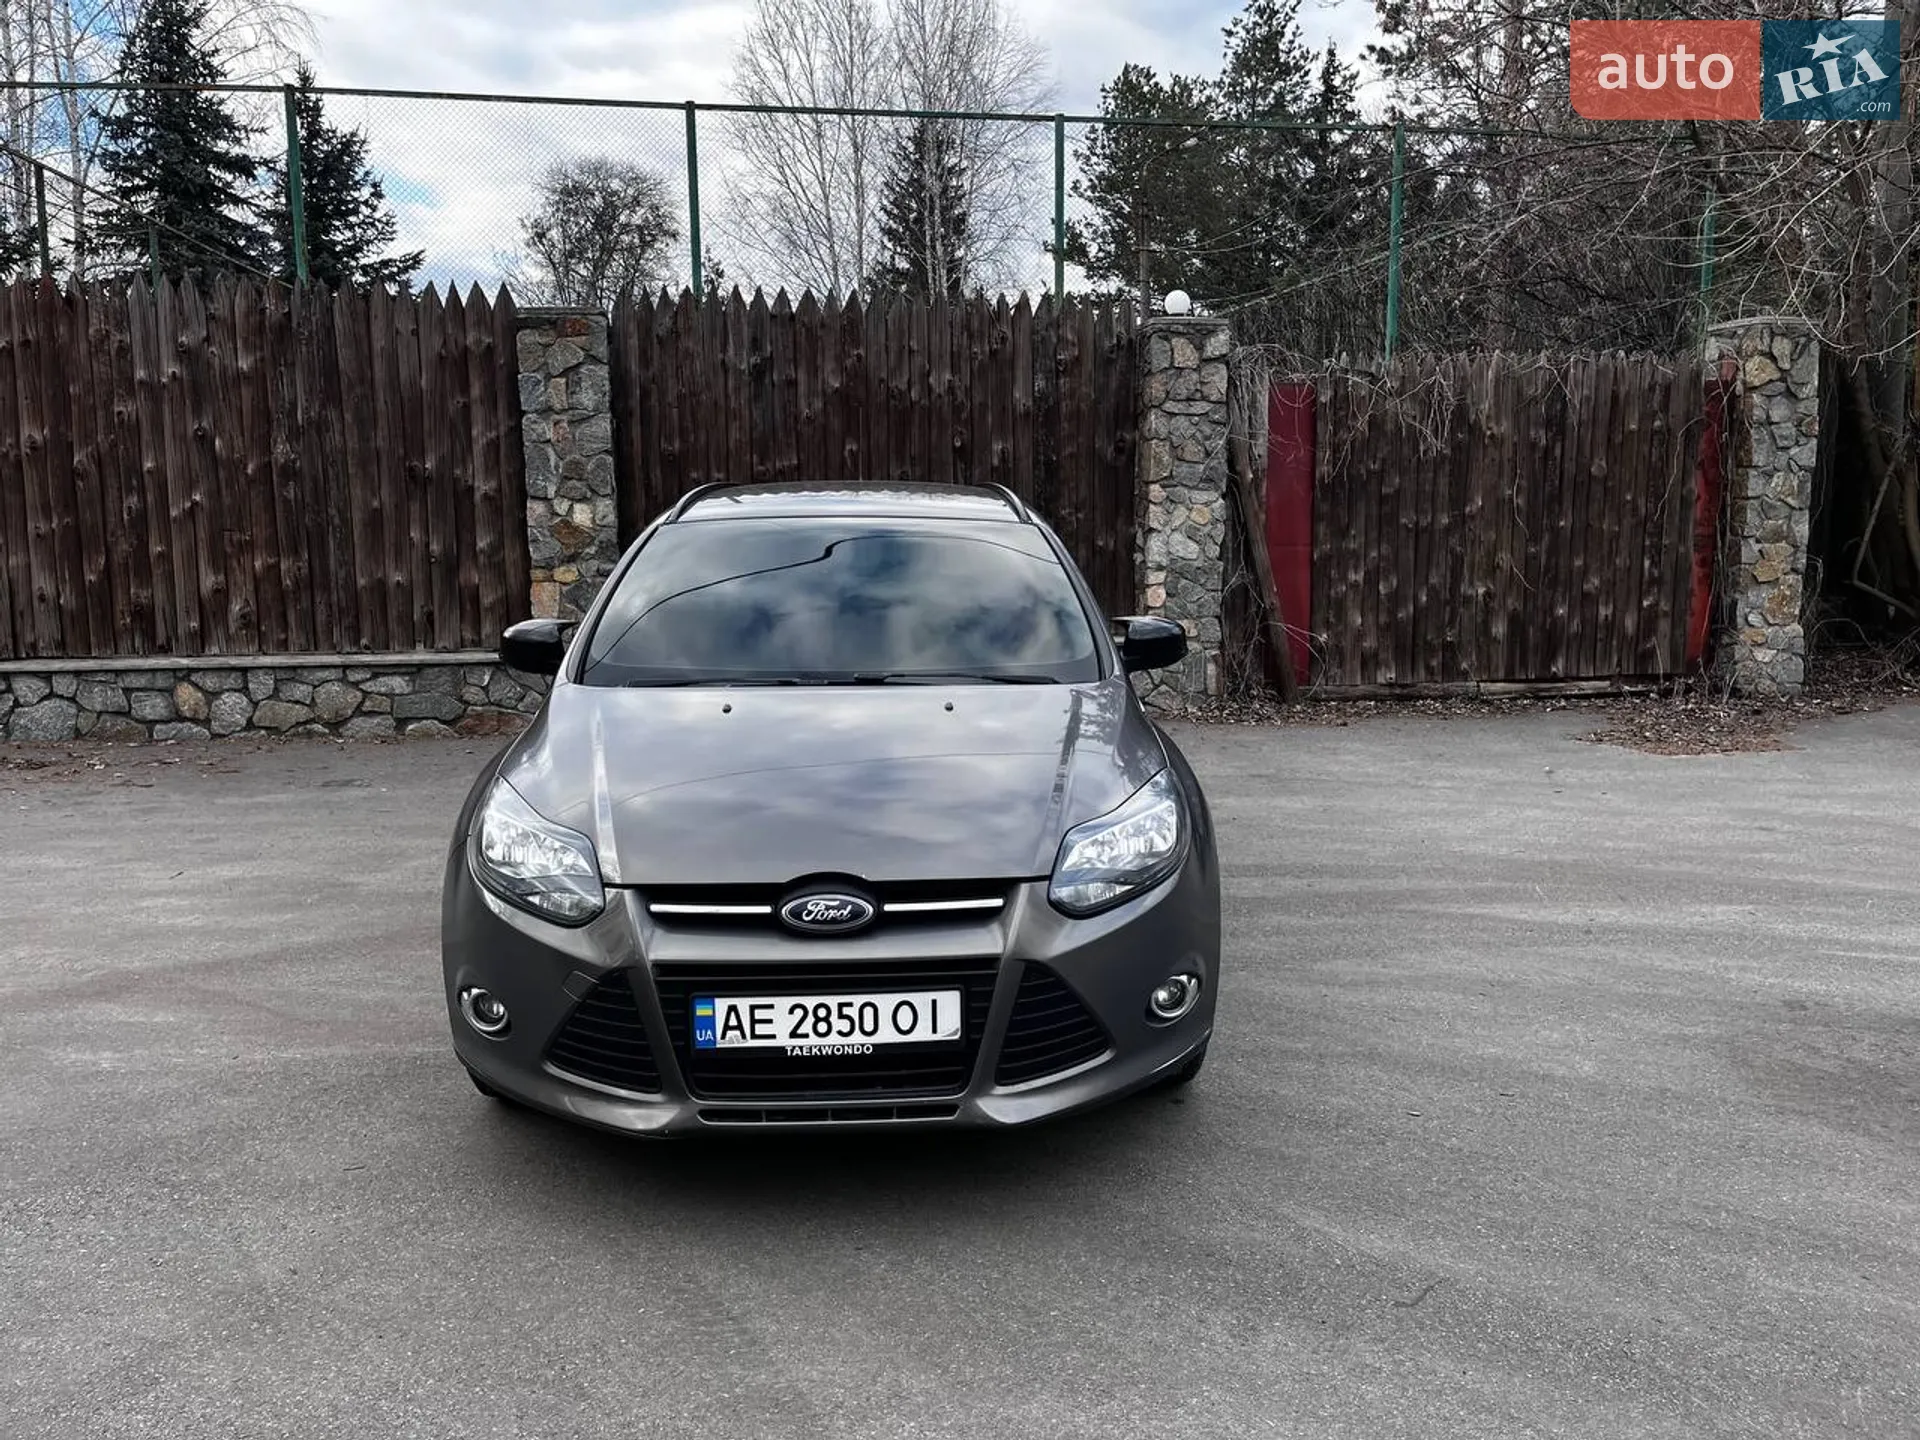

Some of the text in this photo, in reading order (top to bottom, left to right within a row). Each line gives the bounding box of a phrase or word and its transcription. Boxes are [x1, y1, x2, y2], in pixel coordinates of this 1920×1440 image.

[802, 900, 852, 921] Ford
[720, 1003, 776, 1041] AE
[788, 1001, 880, 1040] 2850
[696, 1029, 714, 1042] UA
[785, 1044, 873, 1056] TAEKWONDO
